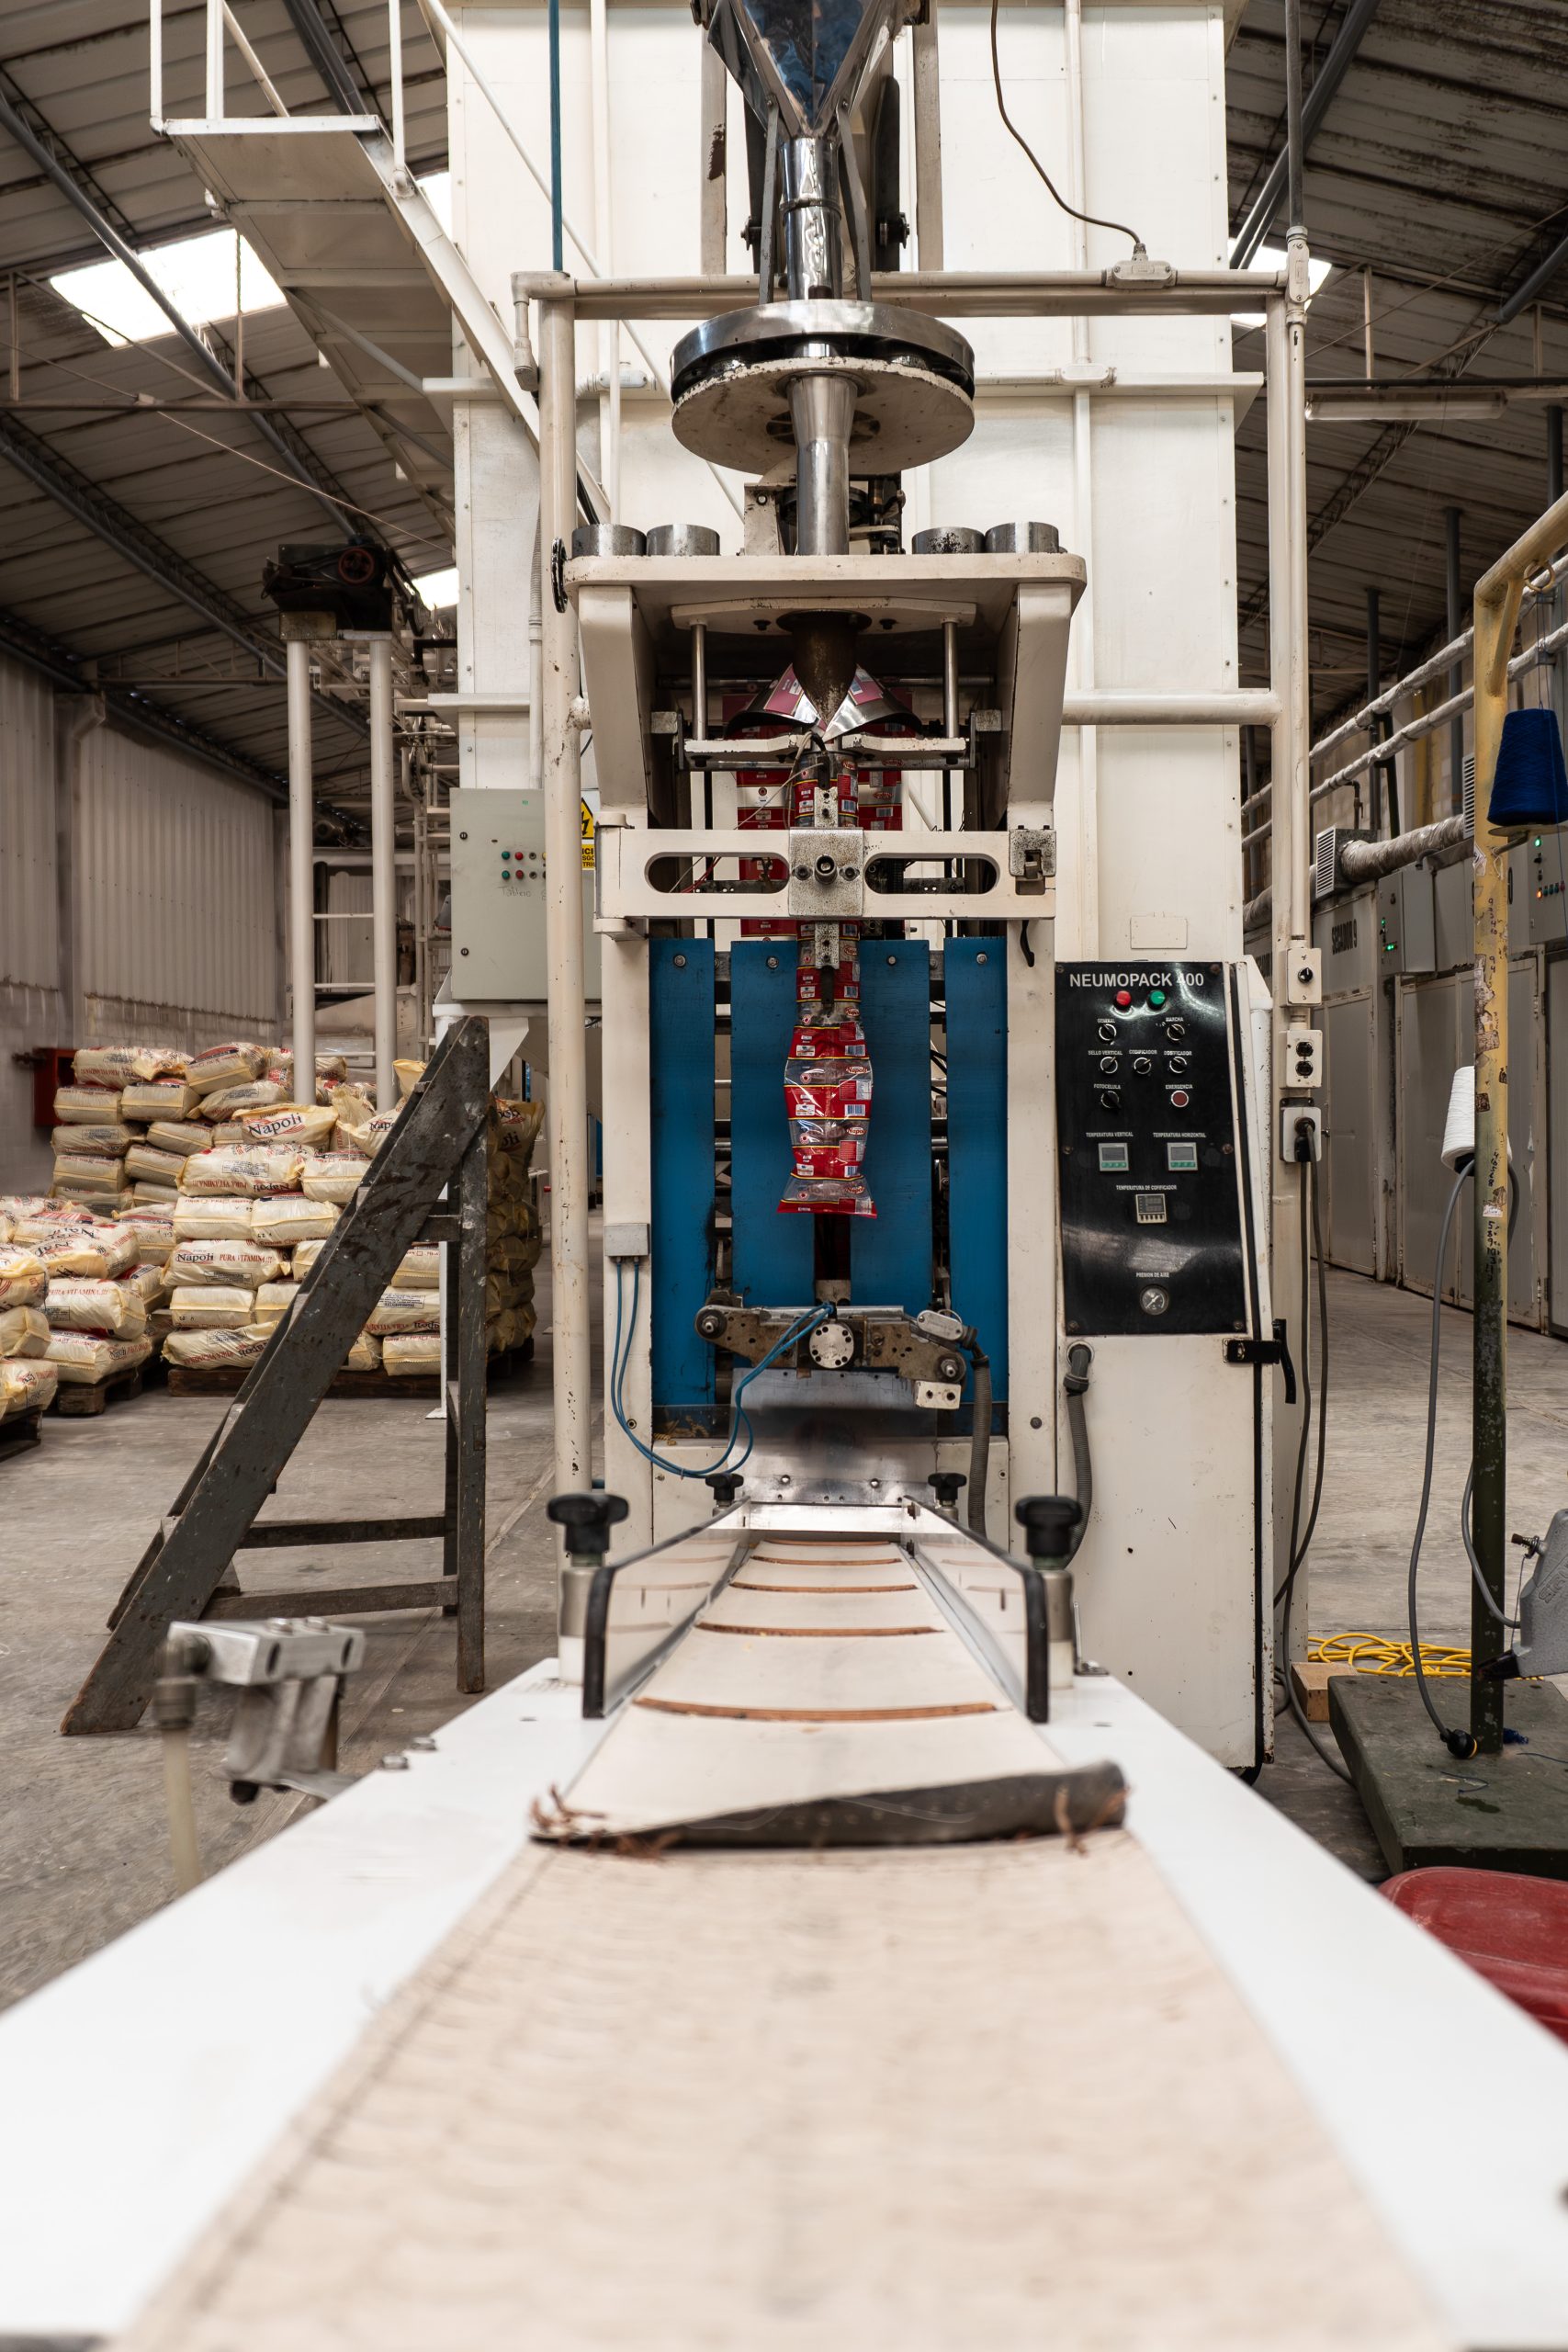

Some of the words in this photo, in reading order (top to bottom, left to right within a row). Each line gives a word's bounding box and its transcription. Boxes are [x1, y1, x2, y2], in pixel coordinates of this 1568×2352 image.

[1353, 919, 1358, 948] 9
[1069, 973, 1172, 988] NEUMOPACK
[1177, 972, 1204, 987] 400
[247, 1112, 302, 1136] Napoli
[231, 1182, 248, 1190] PURA
[253, 1182, 290, 1193] Napoli
[176, 1252, 214, 1263] Napoli
